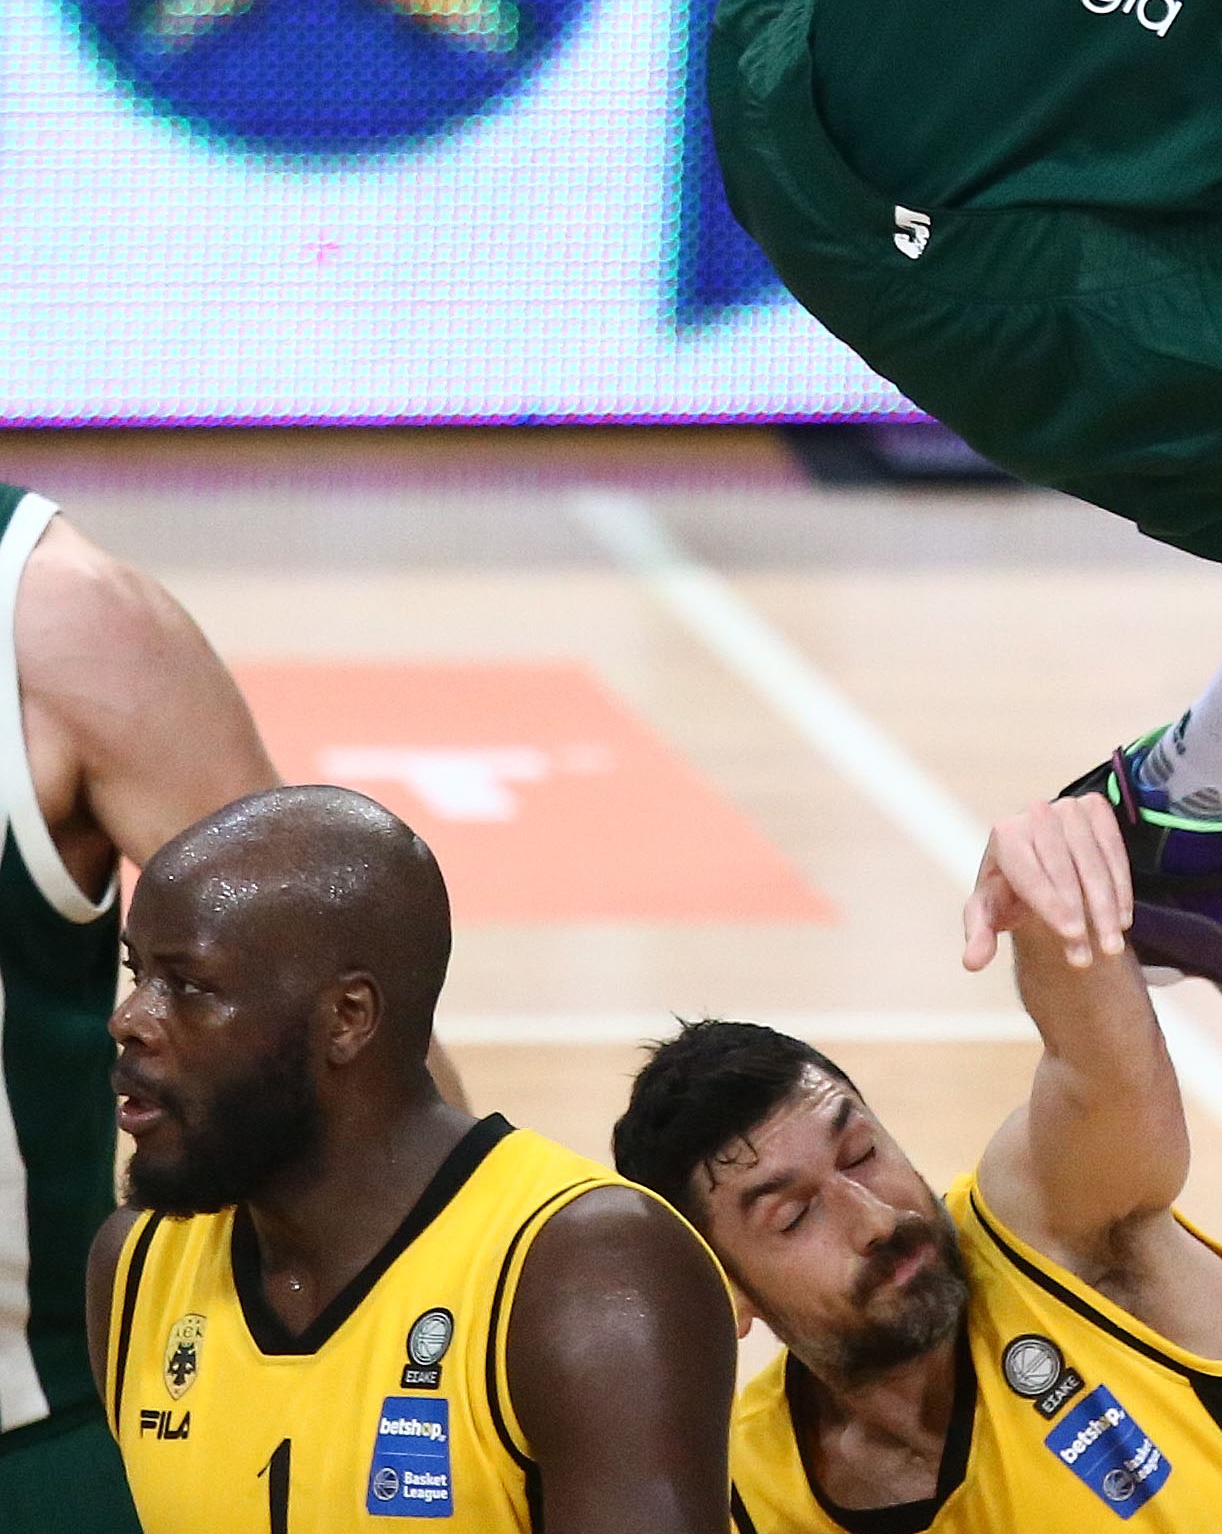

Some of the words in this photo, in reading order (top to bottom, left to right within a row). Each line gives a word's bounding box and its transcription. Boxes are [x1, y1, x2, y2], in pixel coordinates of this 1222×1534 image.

[140, 1409, 191, 1440] FILA
[256, 1437, 292, 1534] 1
[403, 1470, 449, 1487] Basket
[403, 1485, 449, 1503] League
